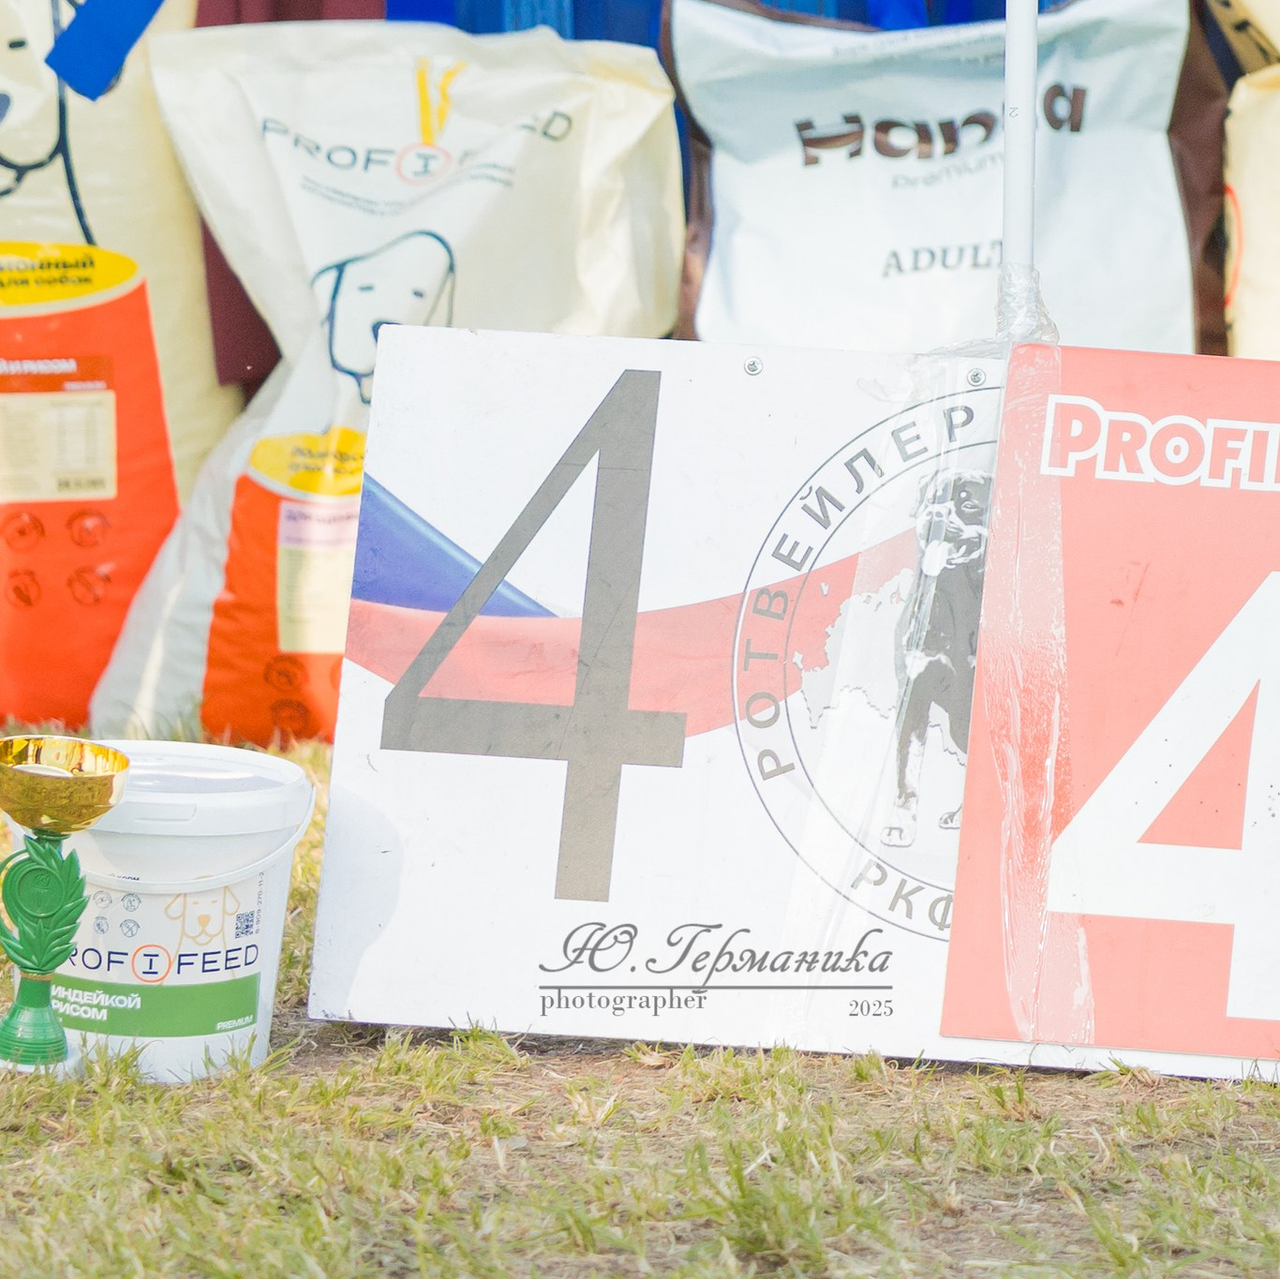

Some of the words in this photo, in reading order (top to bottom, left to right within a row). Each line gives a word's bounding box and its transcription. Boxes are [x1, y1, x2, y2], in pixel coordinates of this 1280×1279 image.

[744, 404, 976, 783] РОТВЕЙЛЕР
[380, 369, 687, 903] 4
[68, 943, 259, 975] ROFIFEED
[51, 984, 142, 1009] ИНДЕЙКОЙ
[51, 999, 108, 1021] РИСОМ
